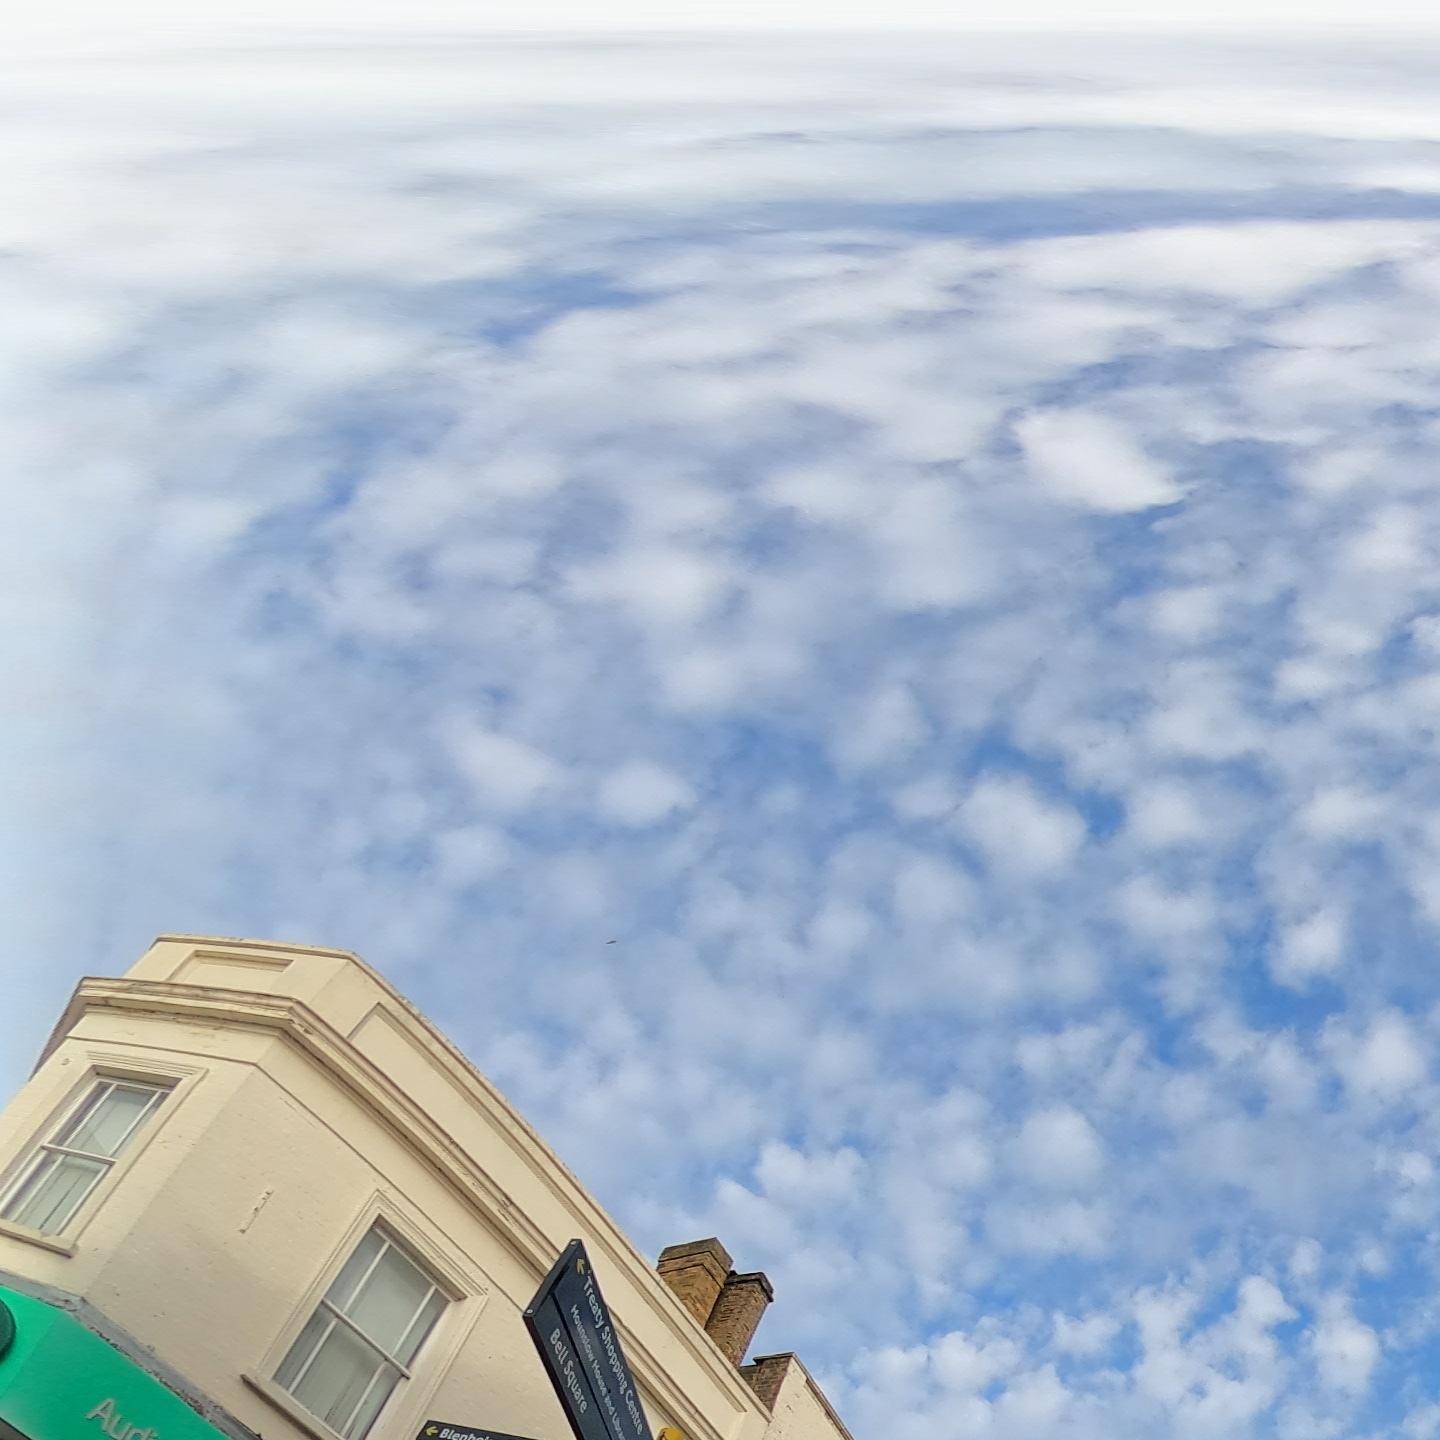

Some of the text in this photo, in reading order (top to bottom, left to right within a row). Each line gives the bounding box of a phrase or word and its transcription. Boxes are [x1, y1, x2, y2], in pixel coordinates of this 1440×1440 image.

[550, 1328, 588, 1414] Bell Square
[583, 1275, 643, 1435] Treaty Shopping Centre
